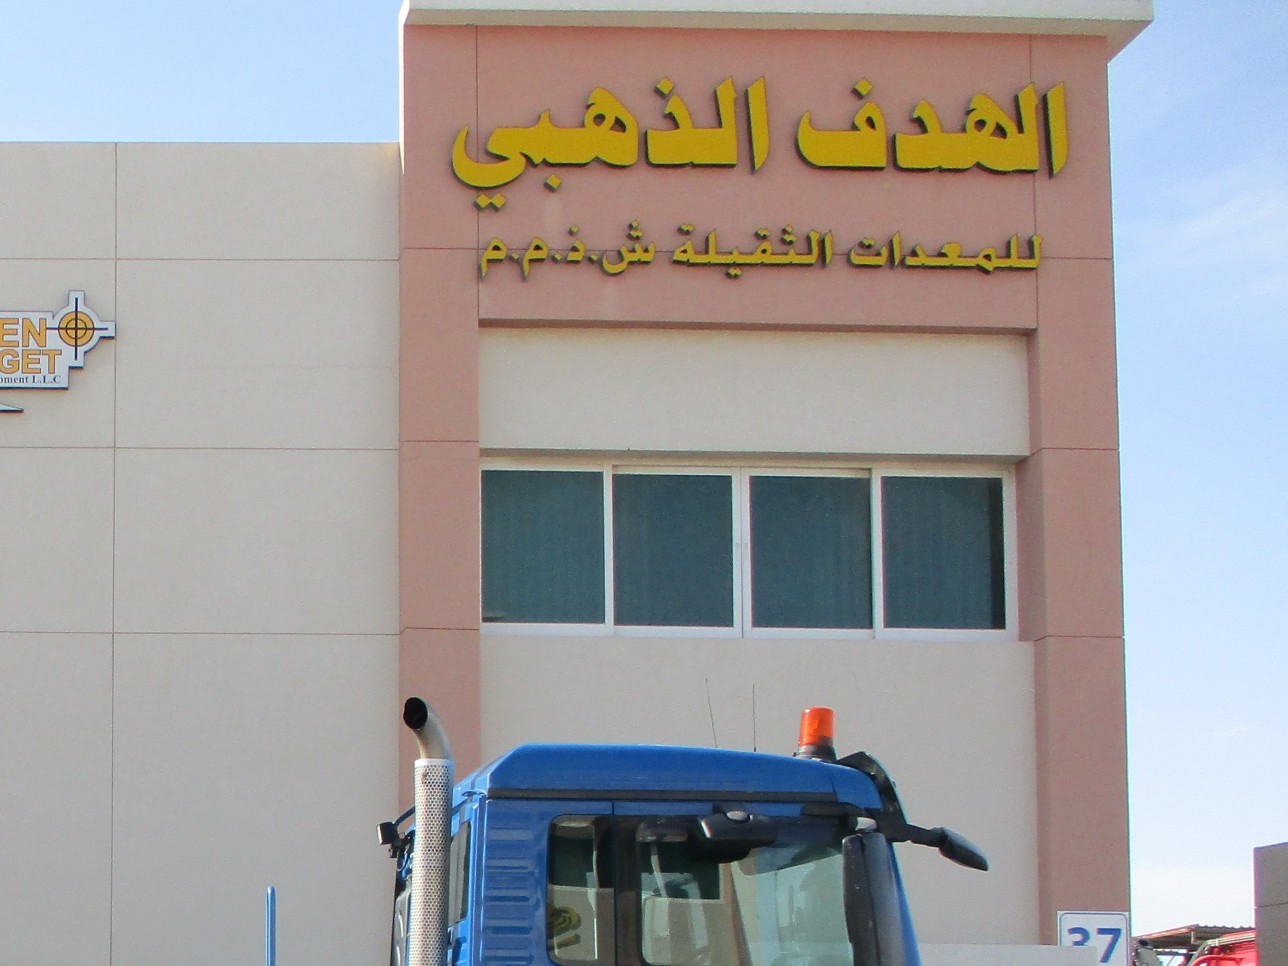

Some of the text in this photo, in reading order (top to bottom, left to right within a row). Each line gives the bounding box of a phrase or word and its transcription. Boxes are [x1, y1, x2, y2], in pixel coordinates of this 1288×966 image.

[451, 76, 1068, 210] الهدف الذهبي
[671, 222, 833, 278] الثقيلة
[848, 230, 1042, 274] للمعدات
[32, 374, 62, 384] L.L.C
